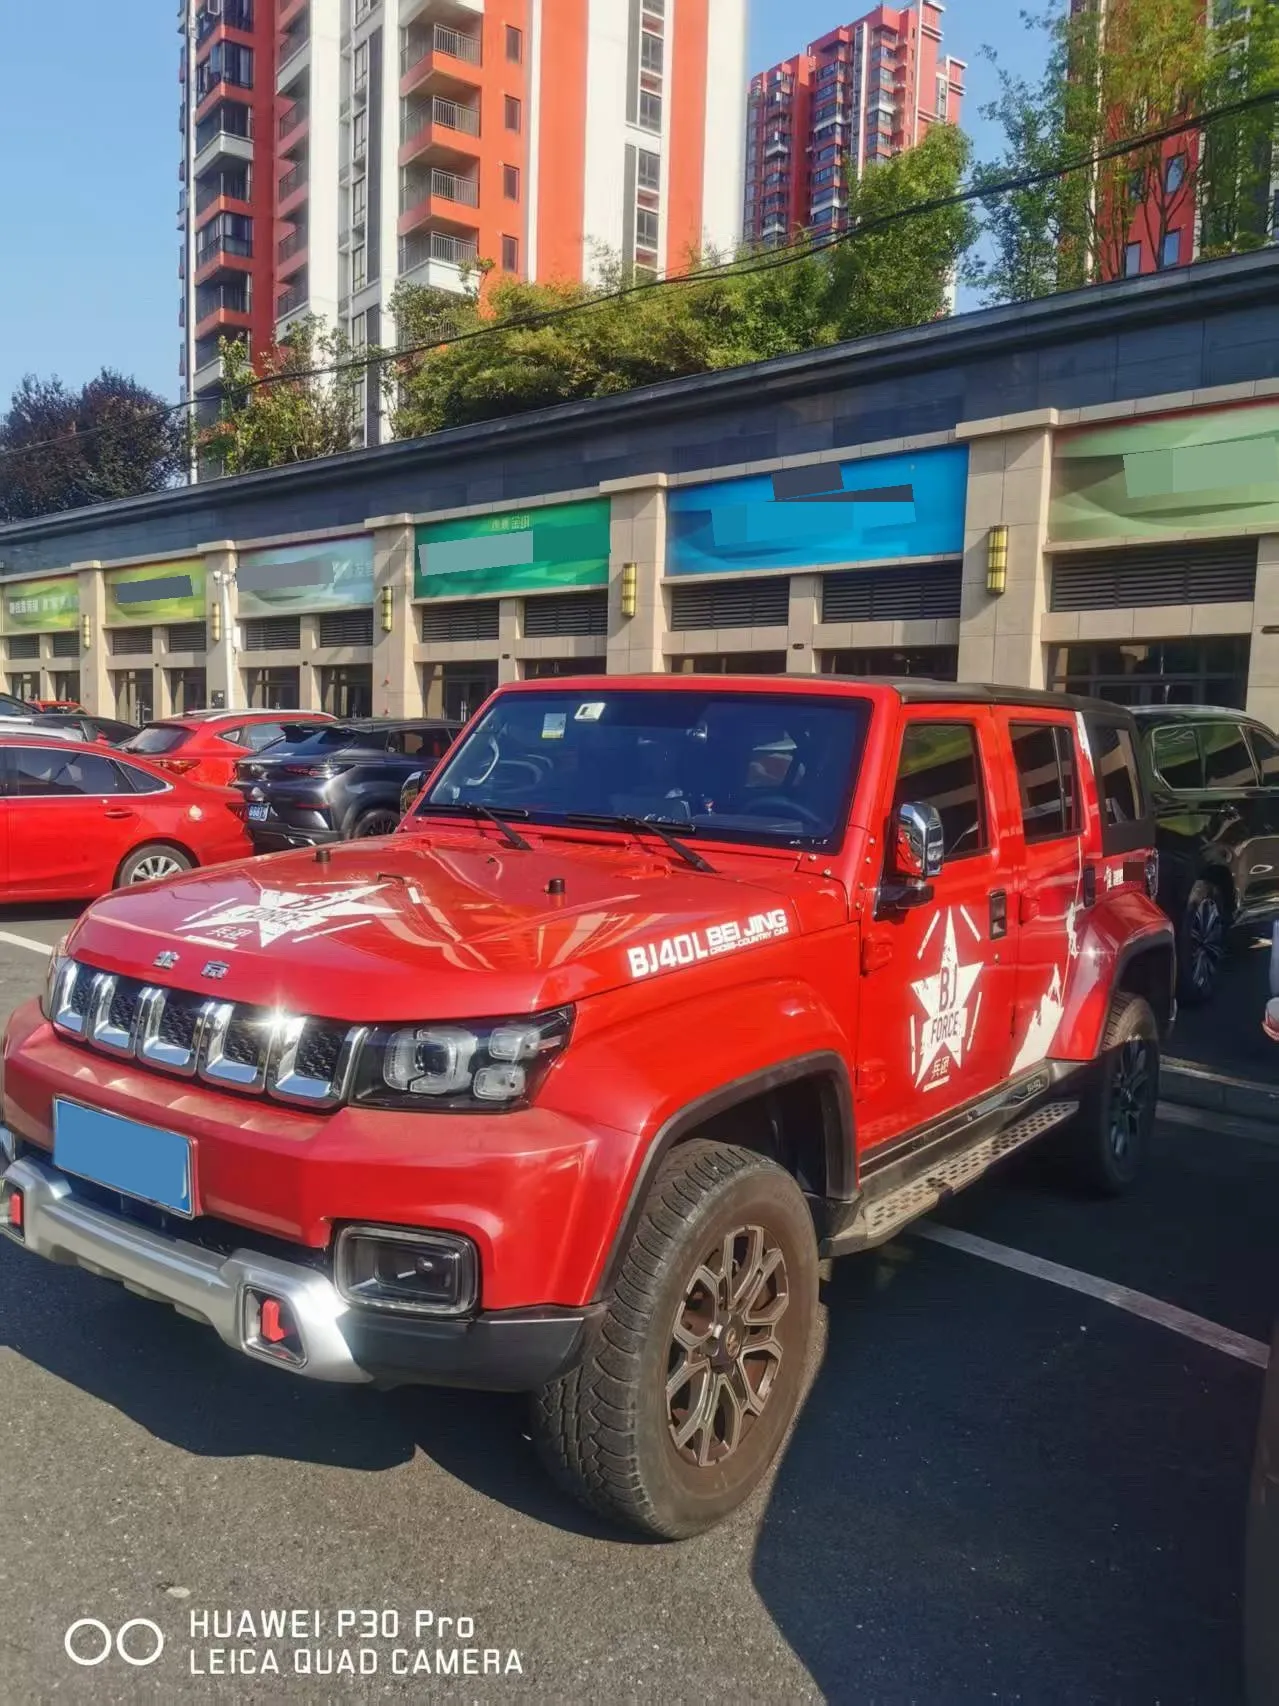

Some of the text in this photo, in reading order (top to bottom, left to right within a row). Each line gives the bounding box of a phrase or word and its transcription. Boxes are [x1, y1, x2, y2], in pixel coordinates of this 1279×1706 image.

[627, 931, 708, 978] BJ40L
[939, 963, 958, 1012] BJ
[930, 1012, 959, 1045] FORCE
